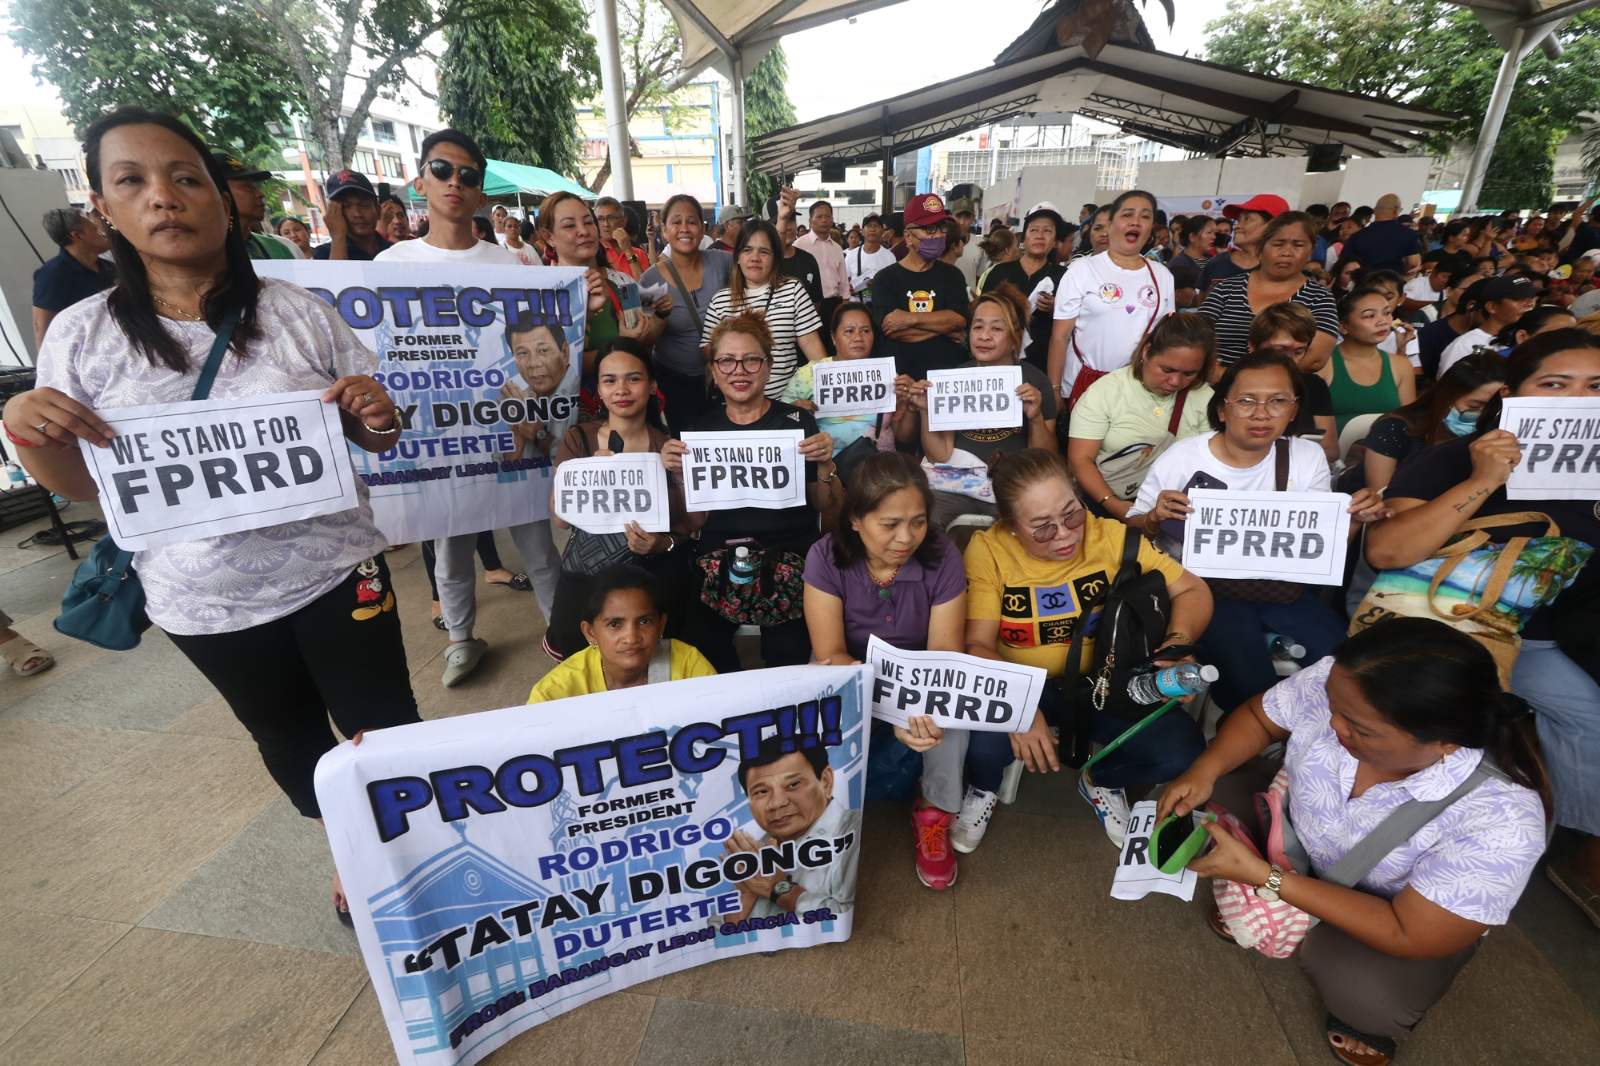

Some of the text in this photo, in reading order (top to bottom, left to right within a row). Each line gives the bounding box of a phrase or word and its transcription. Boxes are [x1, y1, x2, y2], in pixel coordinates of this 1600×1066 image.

[305, 286, 573, 329] OTECT!!!
[387, 349, 478, 361] PRESIDENT
[394, 335, 463, 346] FORMER
[820, 370, 882, 386] WE STAND FOR
[936, 378, 1004, 394] WE STAND FOR
[819, 383, 887, 405] FPRRD
[933, 393, 1010, 415] FPRRD
[109, 415, 302, 466] WE STAND FOR
[1517, 418, 1546, 439] WE
[378, 432, 515, 461] DUTERTE
[692, 446, 782, 463] WE STAND FOR
[1517, 443, 1600, 473] PRR
[112, 446, 324, 514] FPRRD
[563, 469, 644, 487] WE STAND FOR
[691, 465, 790, 491] FPRRD
[560, 488, 651, 514] FPRRD
[1201, 507, 1319, 529] WE STAND FOR
[1193, 528, 1325, 560] FPRRD
[881, 658, 1008, 698] WE STAND FOR
[872, 678, 1013, 724] FPRRD
[366, 695, 843, 843] PROTECT!!!
[577, 787, 675, 818] FORMER
[567, 801, 696, 837] PRESIDENT
[538, 817, 732, 880] RODRIGO
[554, 892, 741, 959] DUTERTE
[529, 942, 653, 999] BARANGAY
[658, 926, 715, 953] LEON
[720, 910, 799, 935] GARCIA
[802, 908, 838, 924] SR.
